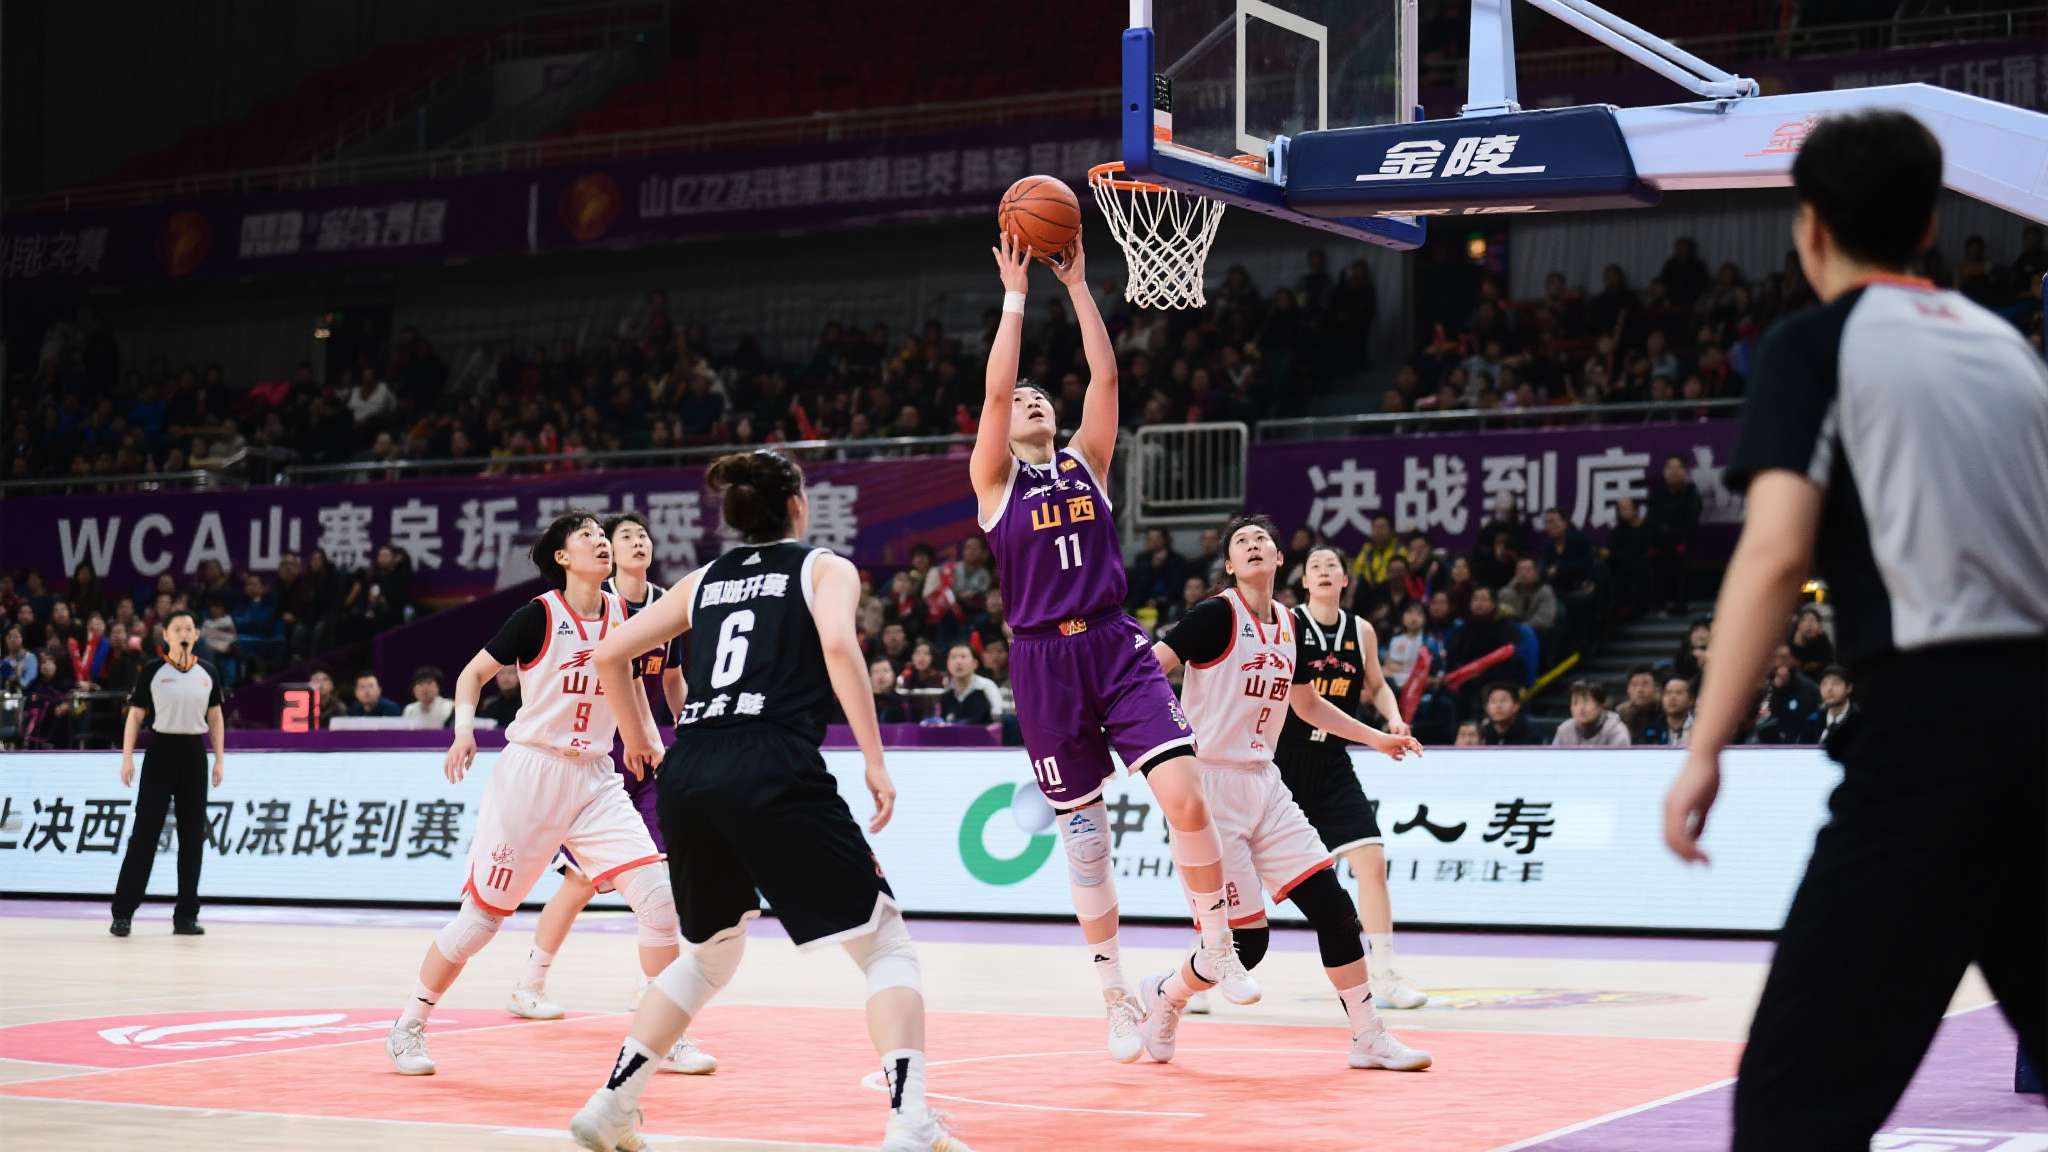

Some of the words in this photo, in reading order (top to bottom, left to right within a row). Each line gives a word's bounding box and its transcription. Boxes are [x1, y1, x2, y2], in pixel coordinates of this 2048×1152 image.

[1356, 135, 1546, 182] 金陵
[1031, 495, 1095, 531] 山西
[1054, 532, 1083, 570] 11
[711, 609, 755, 689] 6
[1244, 675, 1290, 702] 山西
[1035, 756, 1063, 786] 10
